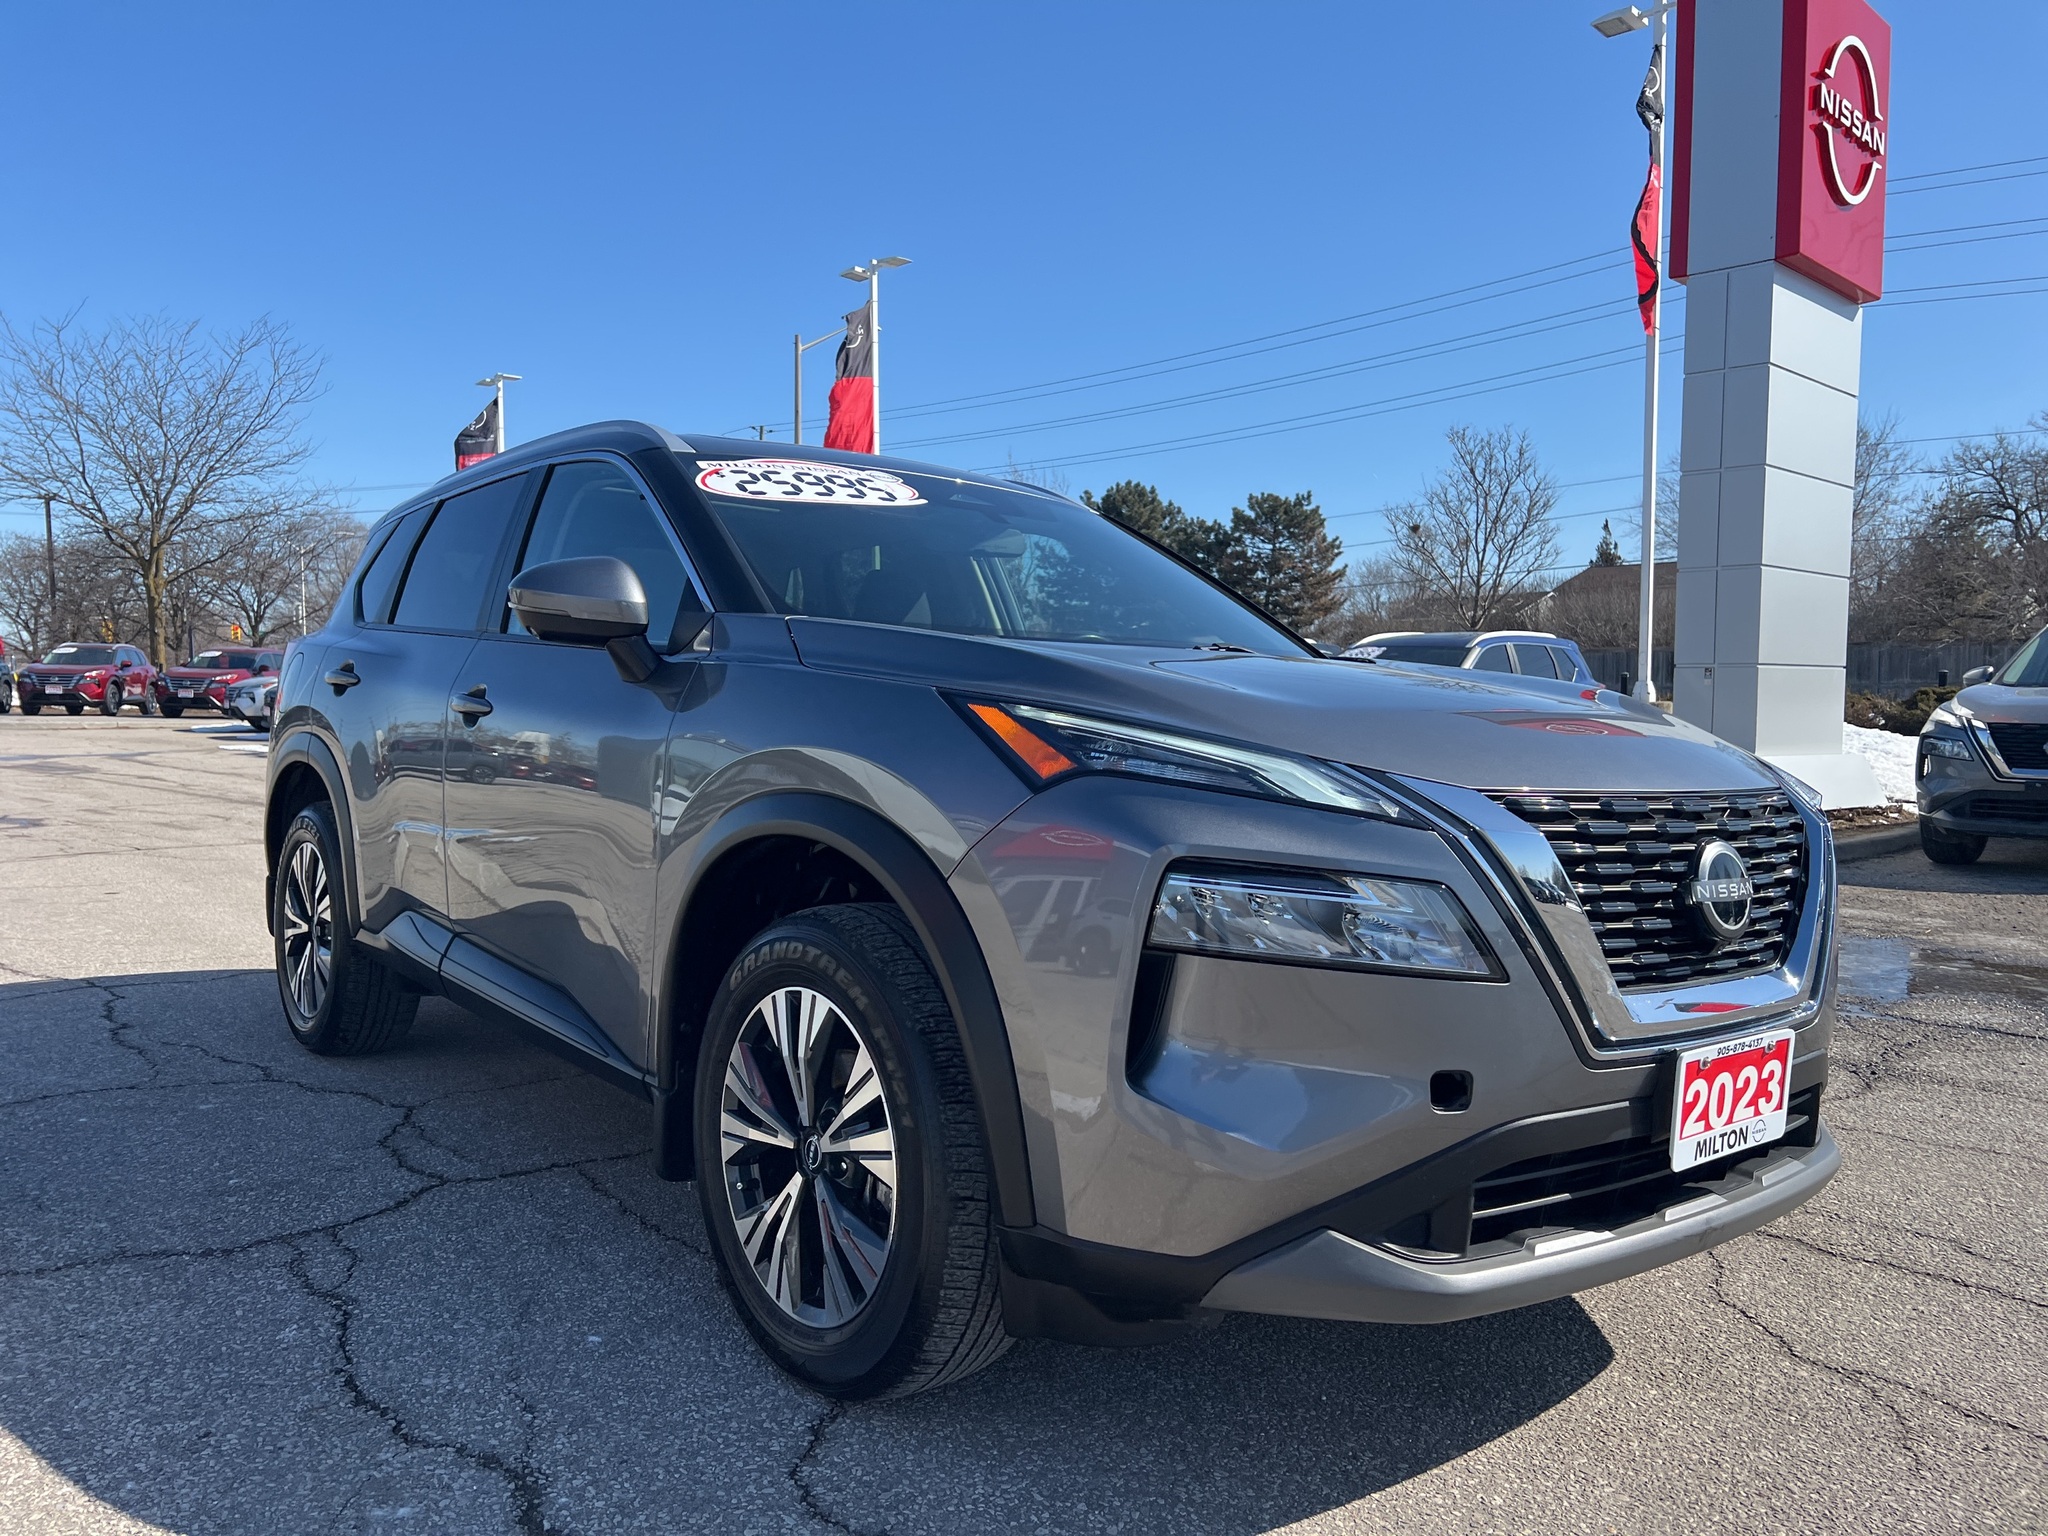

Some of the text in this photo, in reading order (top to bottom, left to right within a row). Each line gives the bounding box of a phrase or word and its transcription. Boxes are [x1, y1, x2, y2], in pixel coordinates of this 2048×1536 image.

[1820, 82, 1885, 156] NISSAN
[1696, 880, 1754, 899] NISSAN
[729, 941, 870, 1012] GRANDTREK
[1716, 1037, 1765, 1057] 905-878-4137
[1681, 1059, 1783, 1139] 2023
[1694, 1125, 1749, 1162] MILTON
